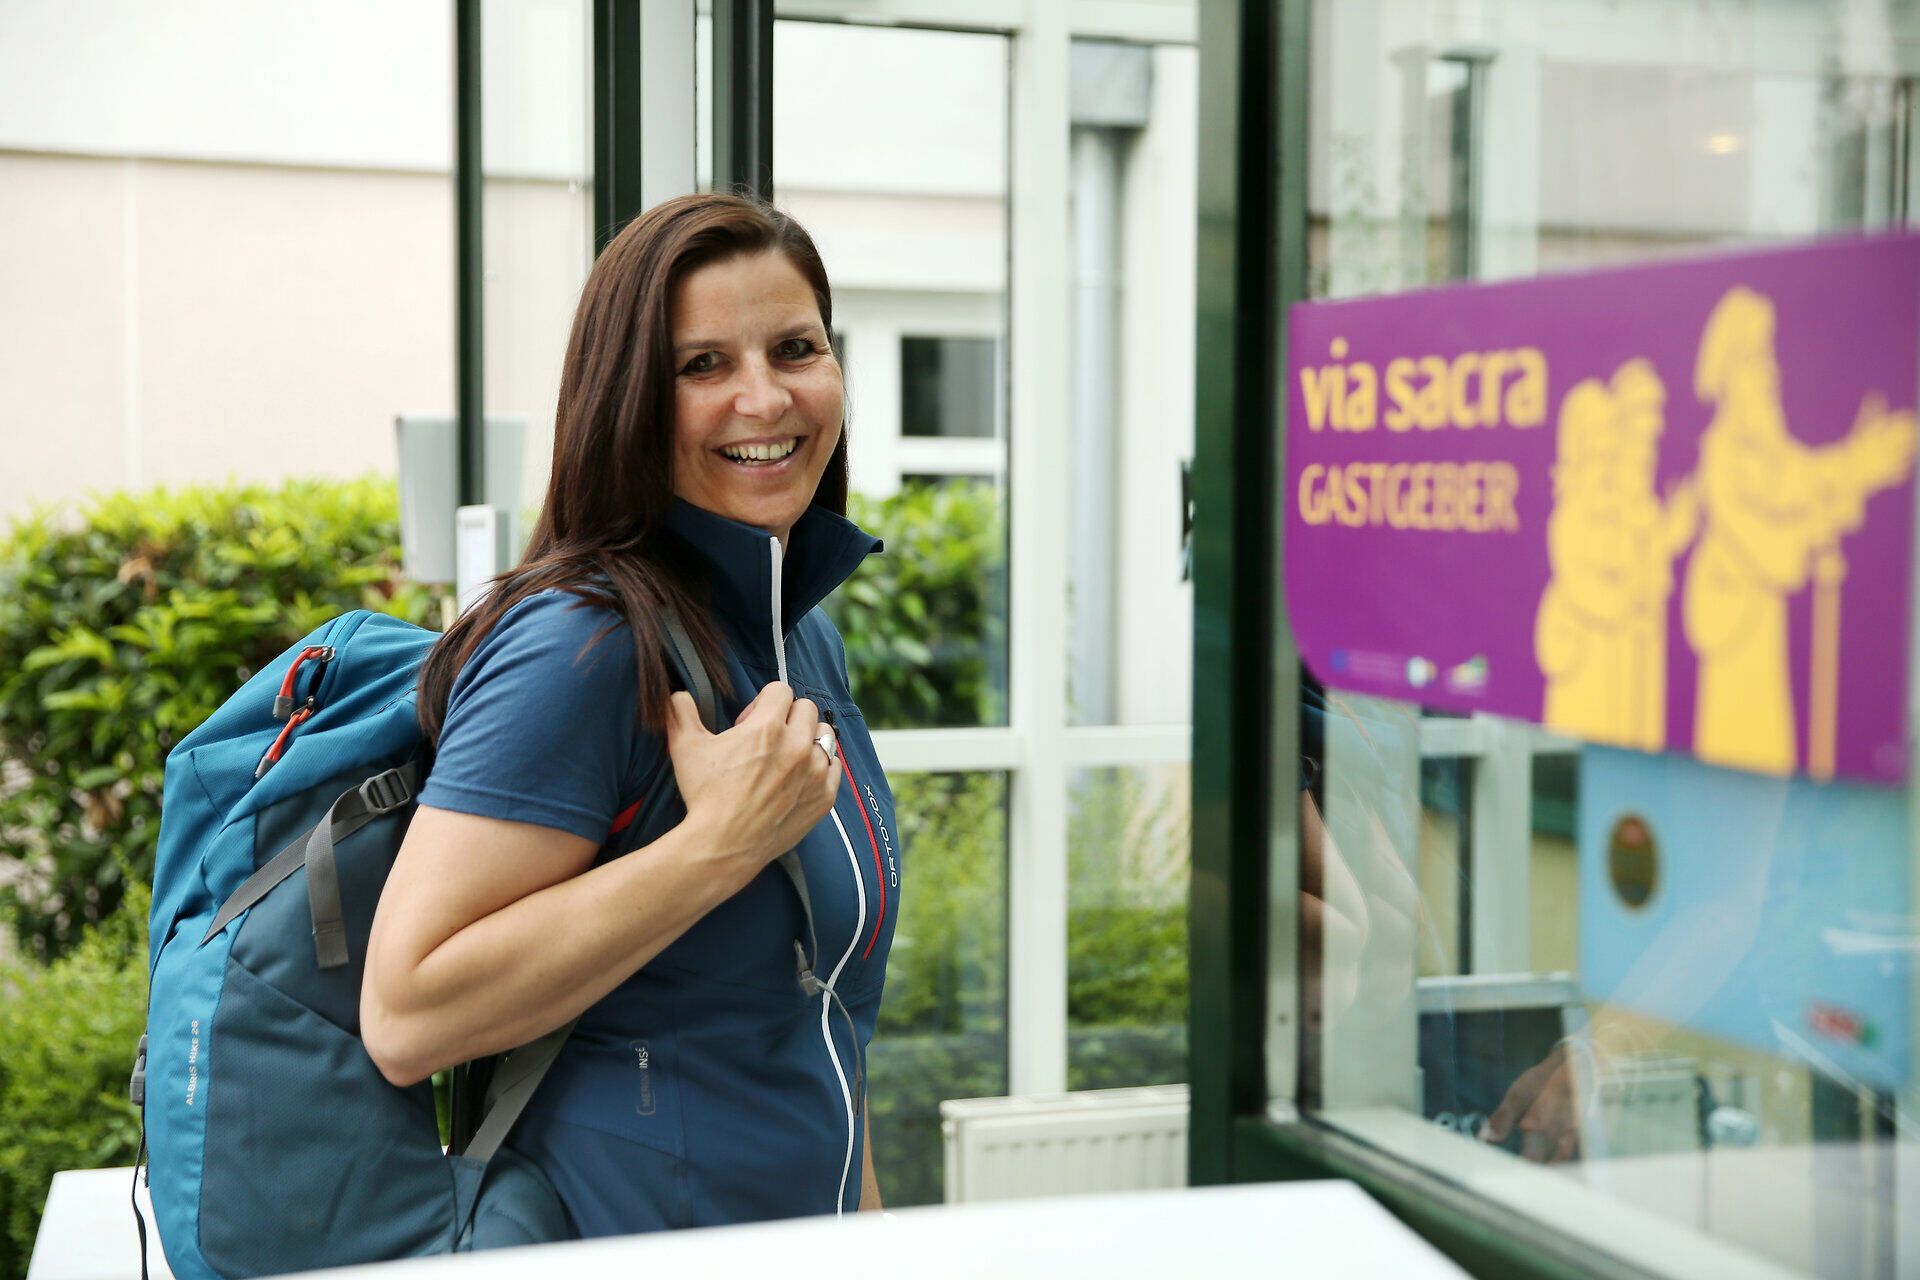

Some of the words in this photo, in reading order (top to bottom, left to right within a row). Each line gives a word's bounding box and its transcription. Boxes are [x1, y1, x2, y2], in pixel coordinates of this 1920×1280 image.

[1300, 336, 1378, 432] via
[1384, 346, 1547, 432] sacra
[1298, 460, 1520, 534] GASTGEBER
[864, 784, 897, 888] ORTOVOX
